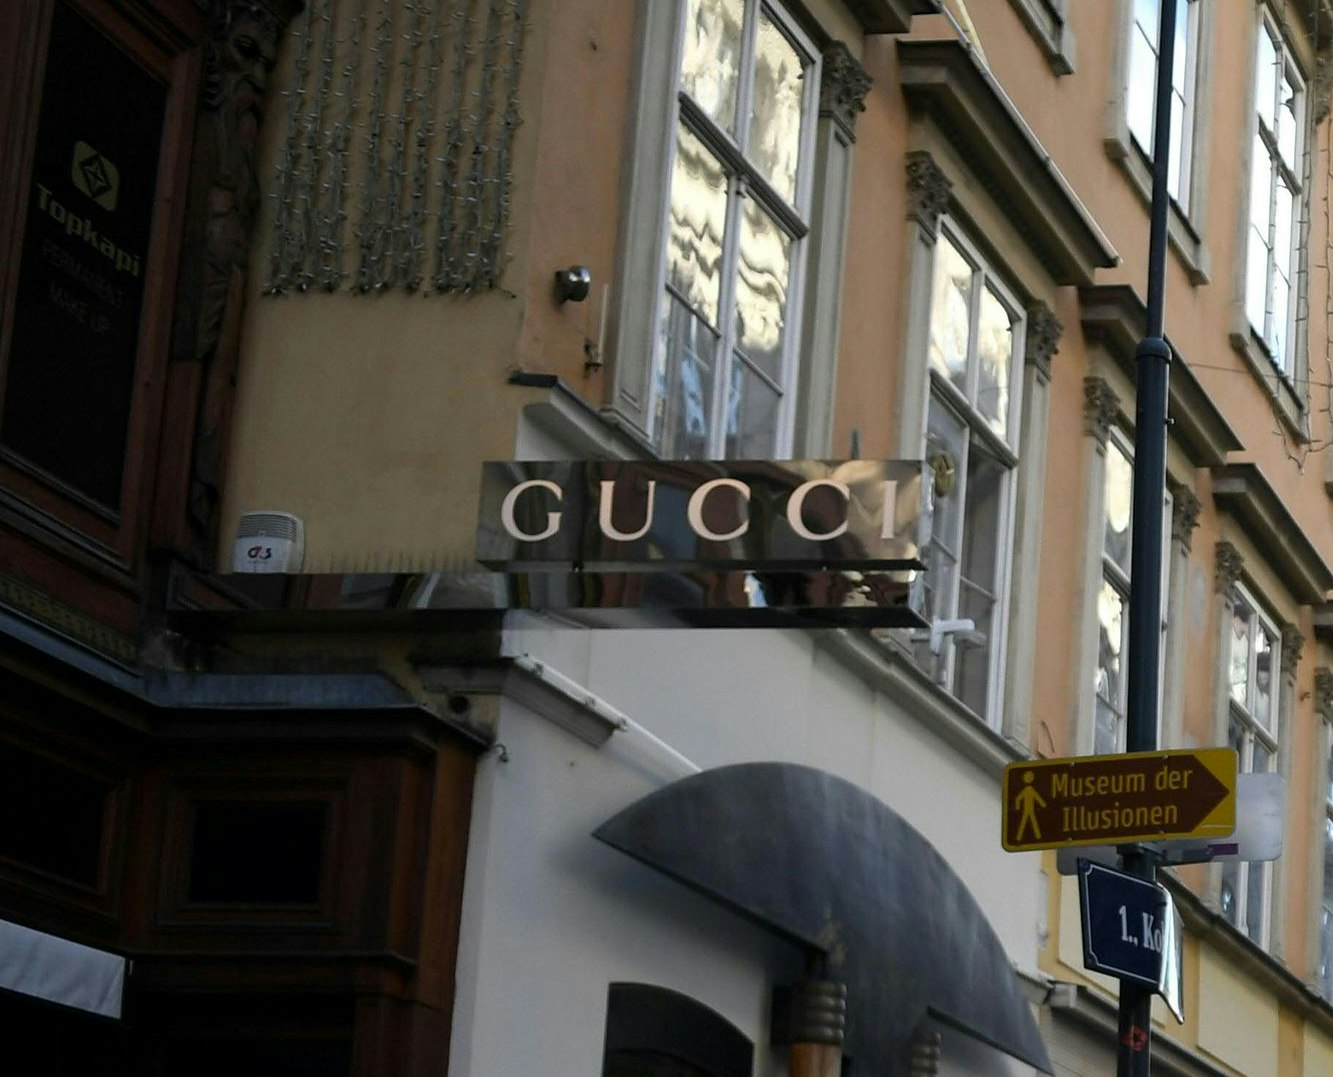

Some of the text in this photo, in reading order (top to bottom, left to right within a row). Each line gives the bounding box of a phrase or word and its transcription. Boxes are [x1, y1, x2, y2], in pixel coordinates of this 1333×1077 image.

[36, 182, 141, 277] Topkapi
[501, 478, 899, 542] GUCCI
[1052, 766, 1193, 798] Museum der
[1063, 802, 1178, 833] Illusionen
